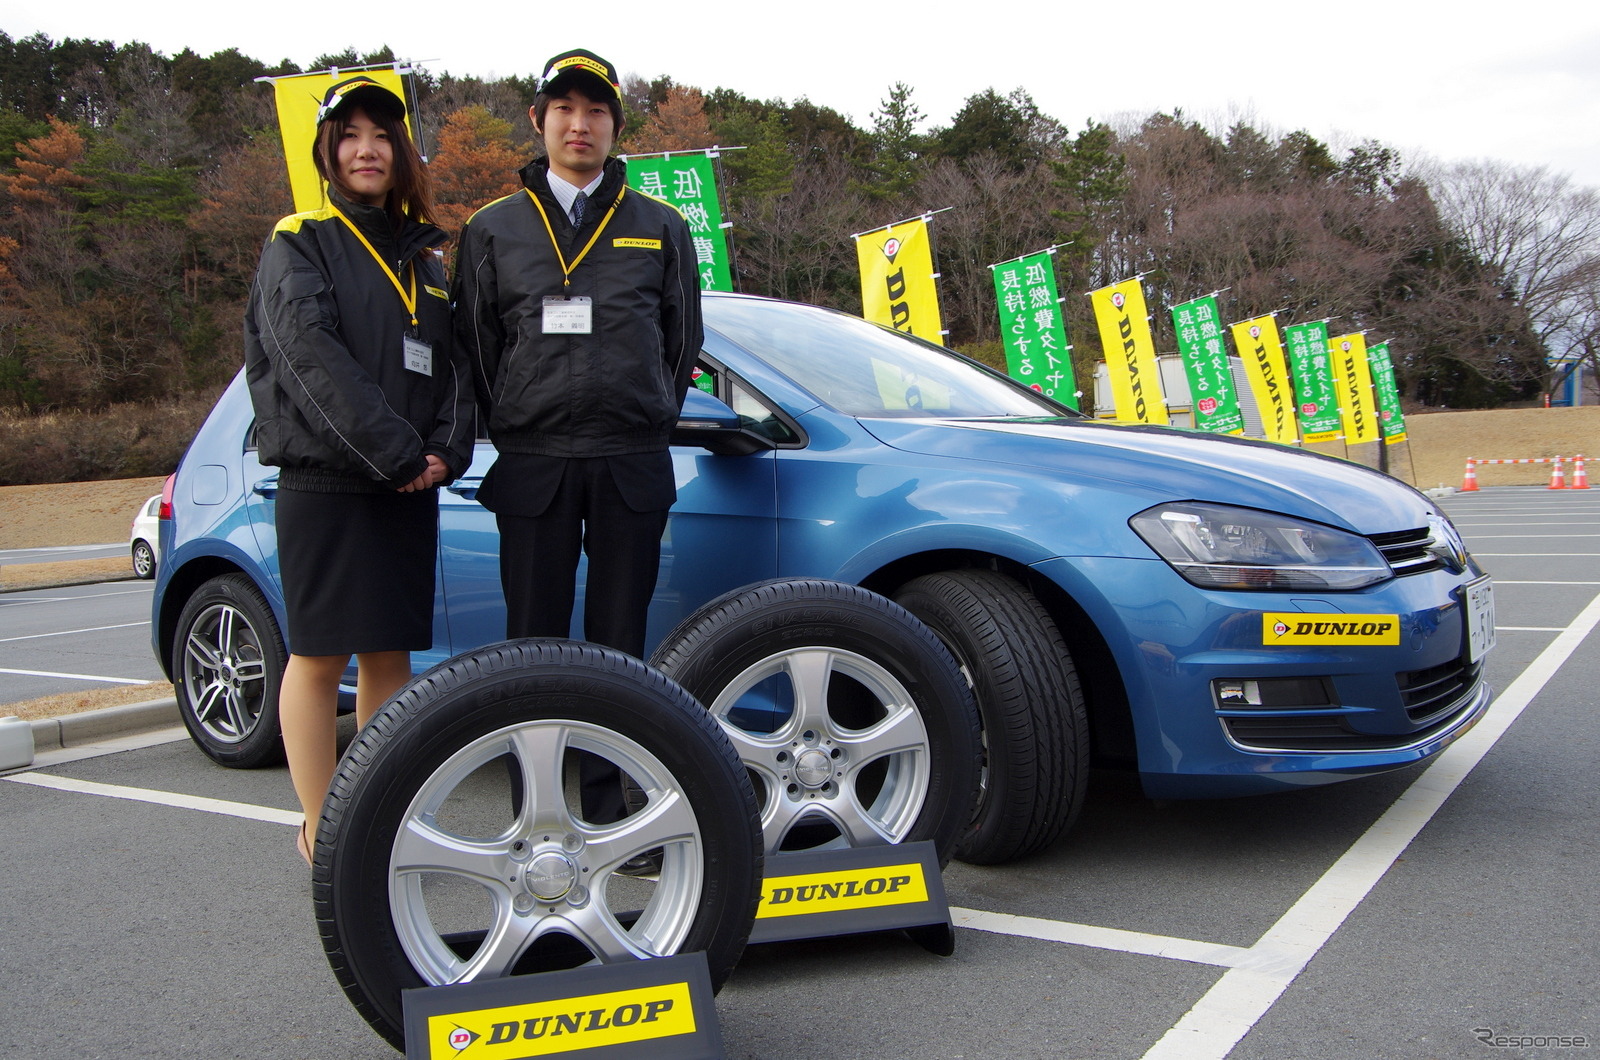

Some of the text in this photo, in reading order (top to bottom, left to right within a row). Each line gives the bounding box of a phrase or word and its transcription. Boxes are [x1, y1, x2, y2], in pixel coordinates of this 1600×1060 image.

[564, 57, 605, 72] DUNLOP
[1293, 622, 1392, 636] DUNLOP
[768, 875, 911, 905] DUNLOP
[485, 998, 674, 1046] DUNLOP
